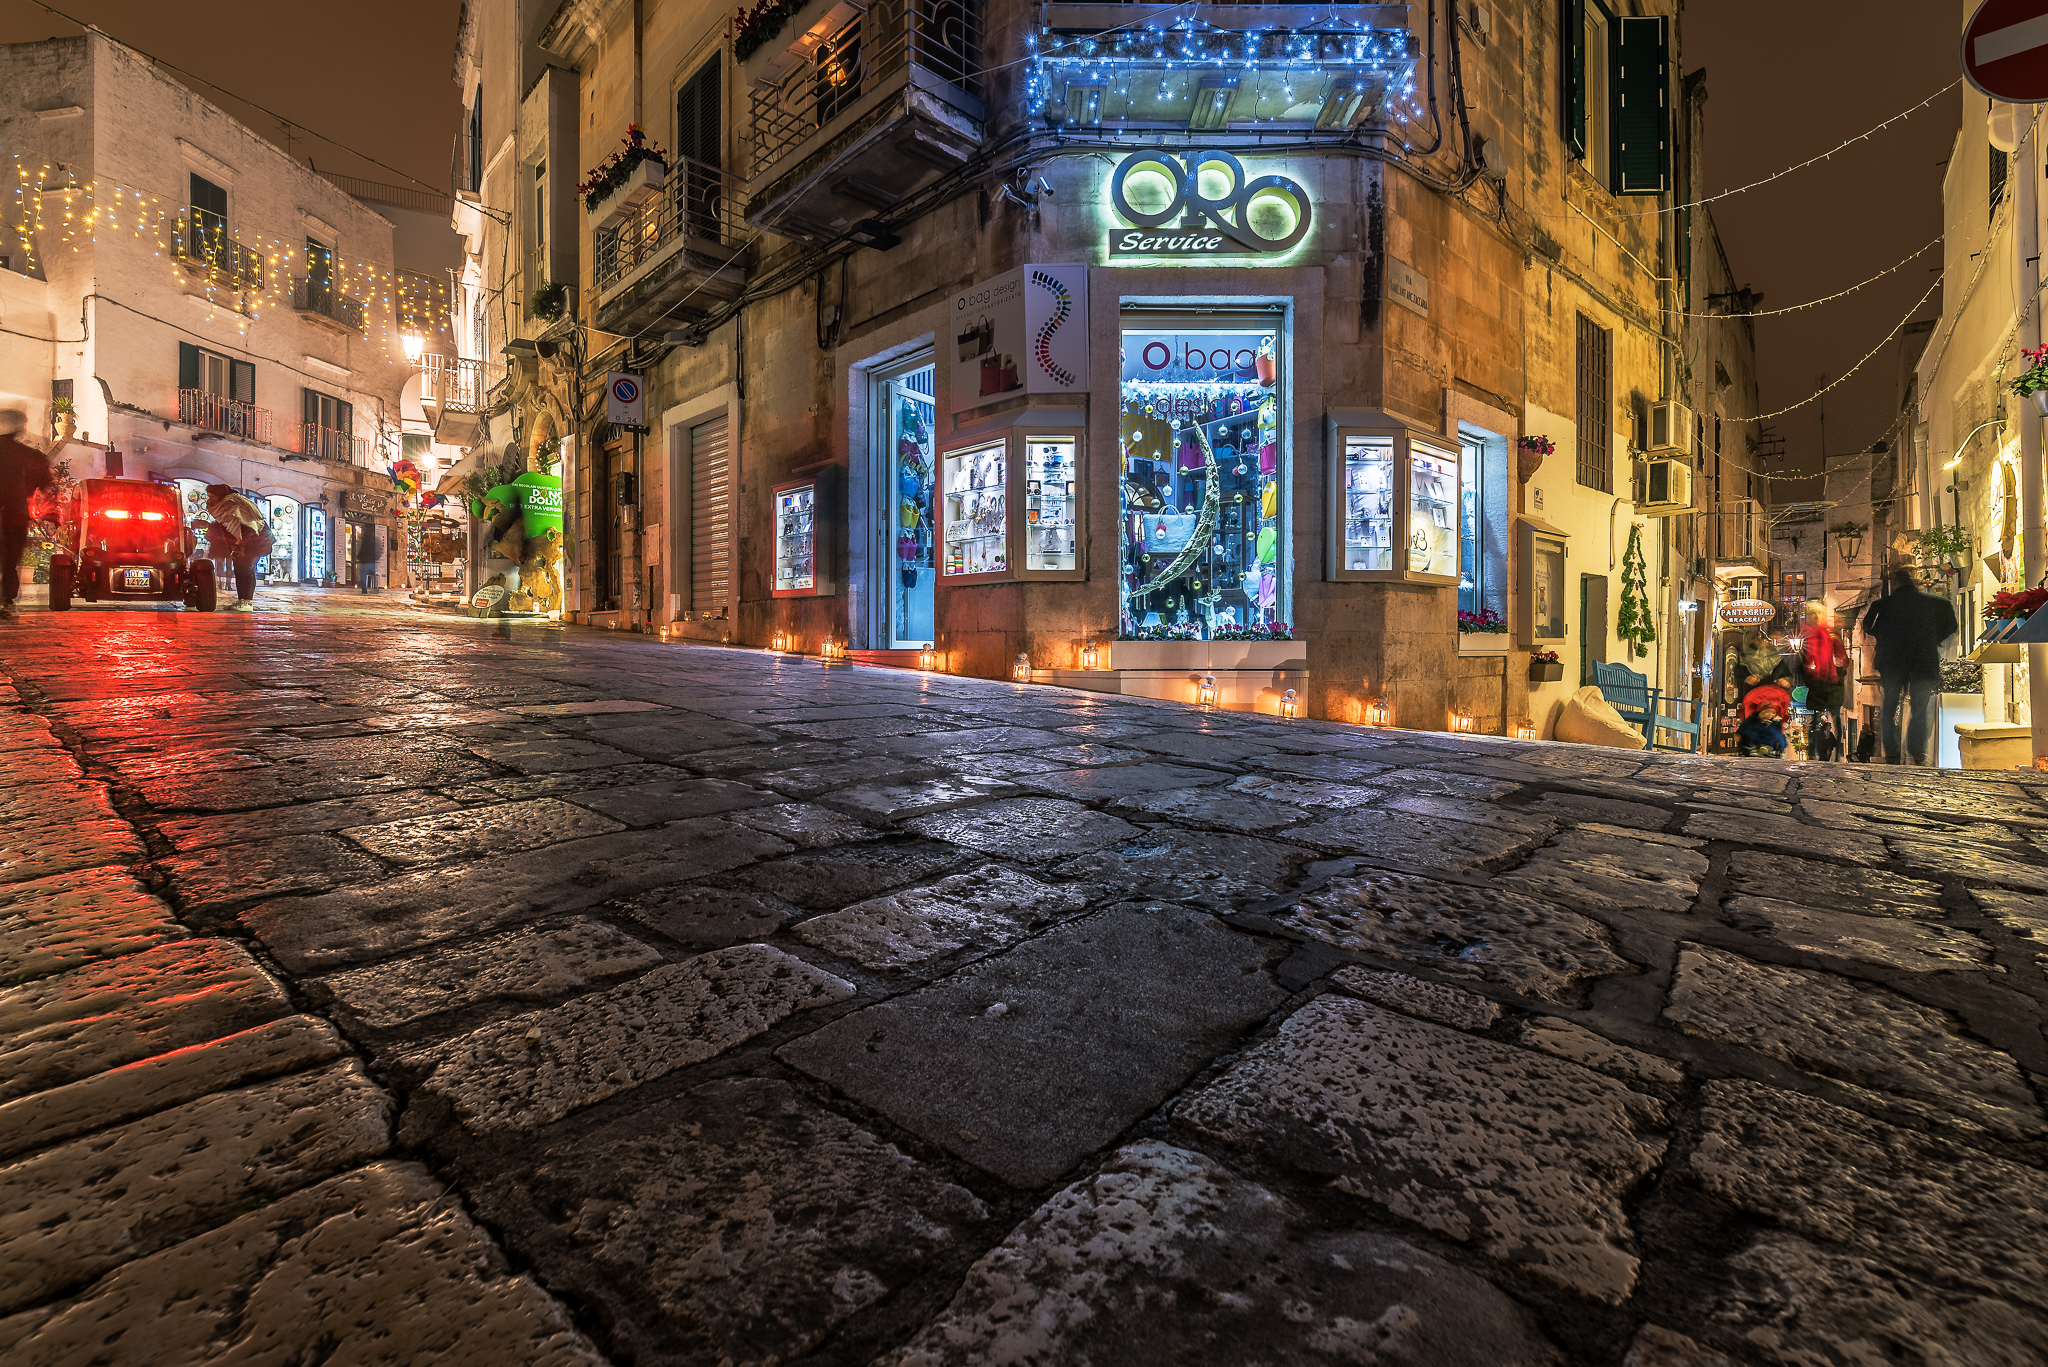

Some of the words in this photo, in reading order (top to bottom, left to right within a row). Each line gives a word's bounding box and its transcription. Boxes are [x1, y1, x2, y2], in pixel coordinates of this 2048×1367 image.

[1111, 149, 1312, 252] ORO
[1118, 231, 1223, 252] Service
[968, 289, 991, 306] bag
[993, 278, 1021, 297] design
[1185, 341, 1257, 378] bag
[1155, 393, 1243, 420] design
[529, 495, 562, 507] DOLIV
[1720, 608, 1776, 616] PANTAGRUEL
